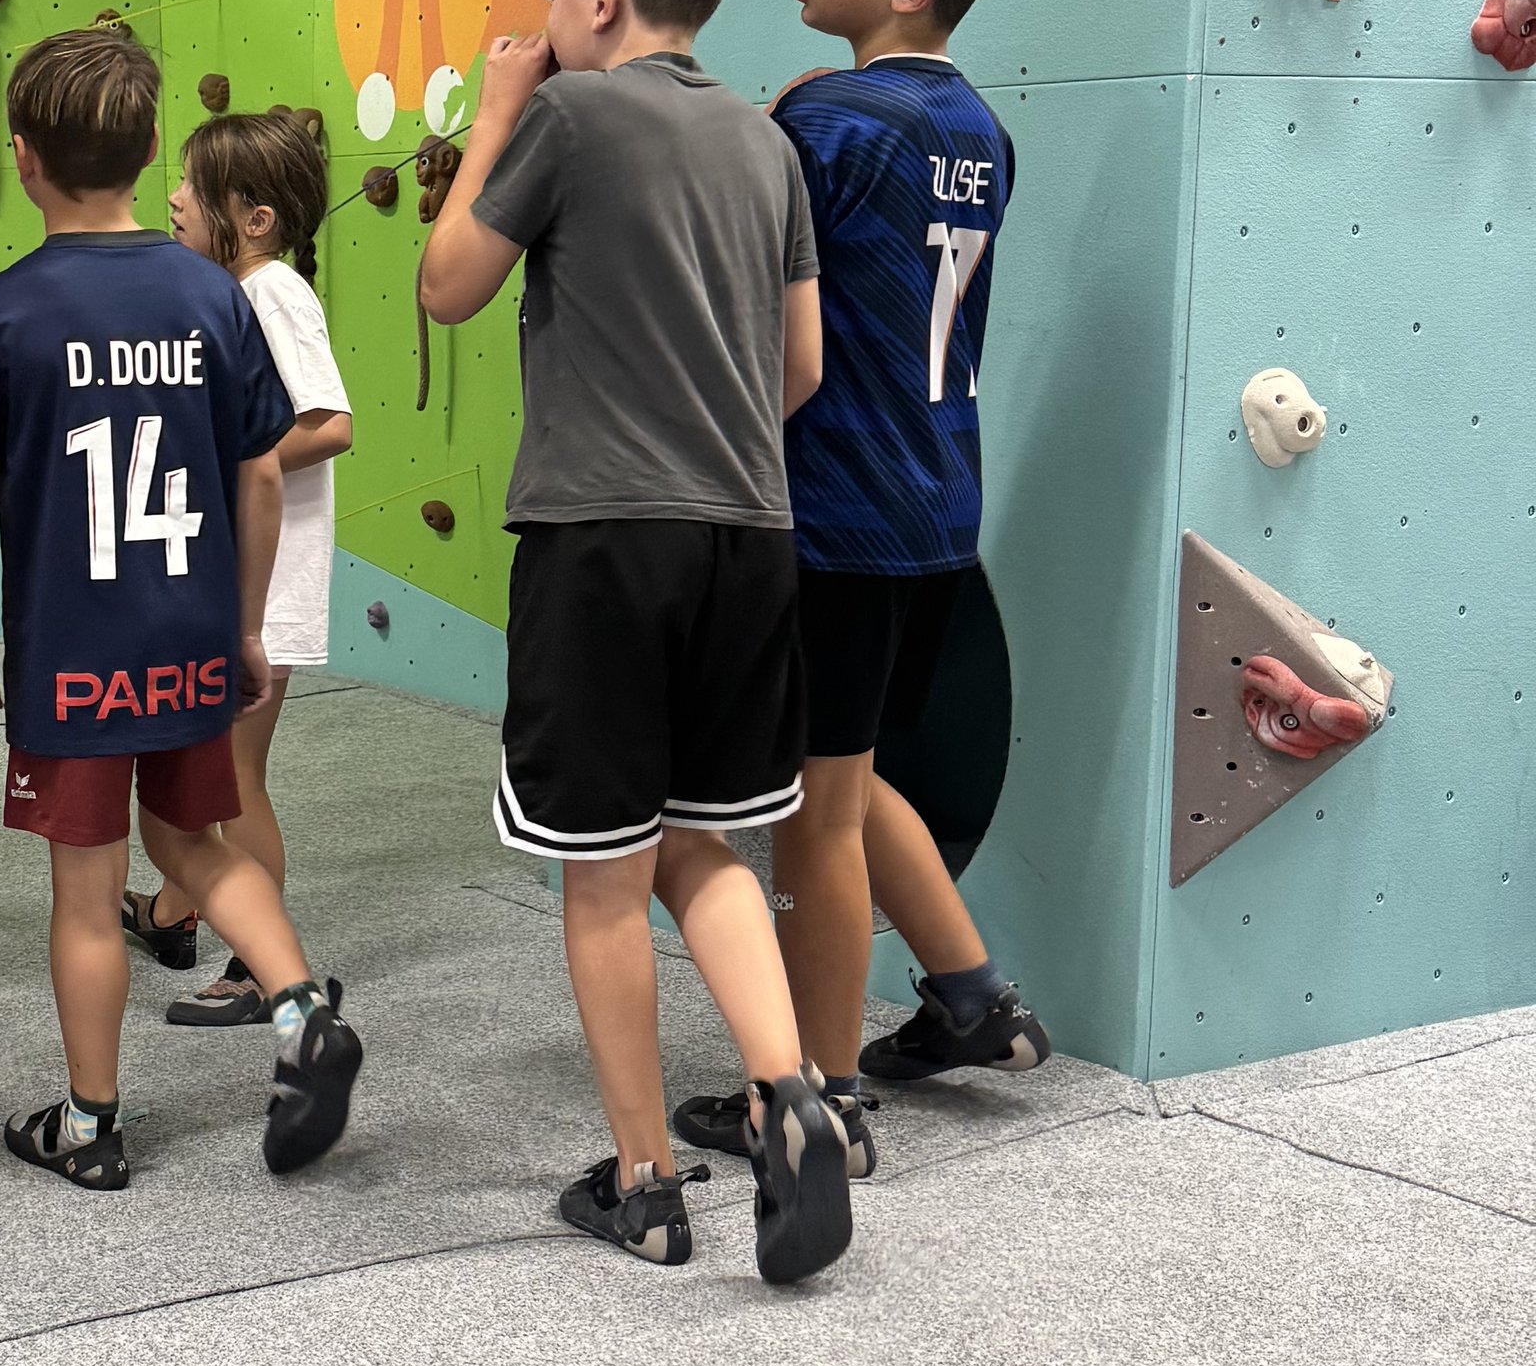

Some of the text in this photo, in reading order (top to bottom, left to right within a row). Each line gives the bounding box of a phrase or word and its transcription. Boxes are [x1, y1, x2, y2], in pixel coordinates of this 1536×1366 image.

[926, 222, 990, 403] 17
[66, 416, 204, 580] 14
[55, 656, 227, 722] PARIS
